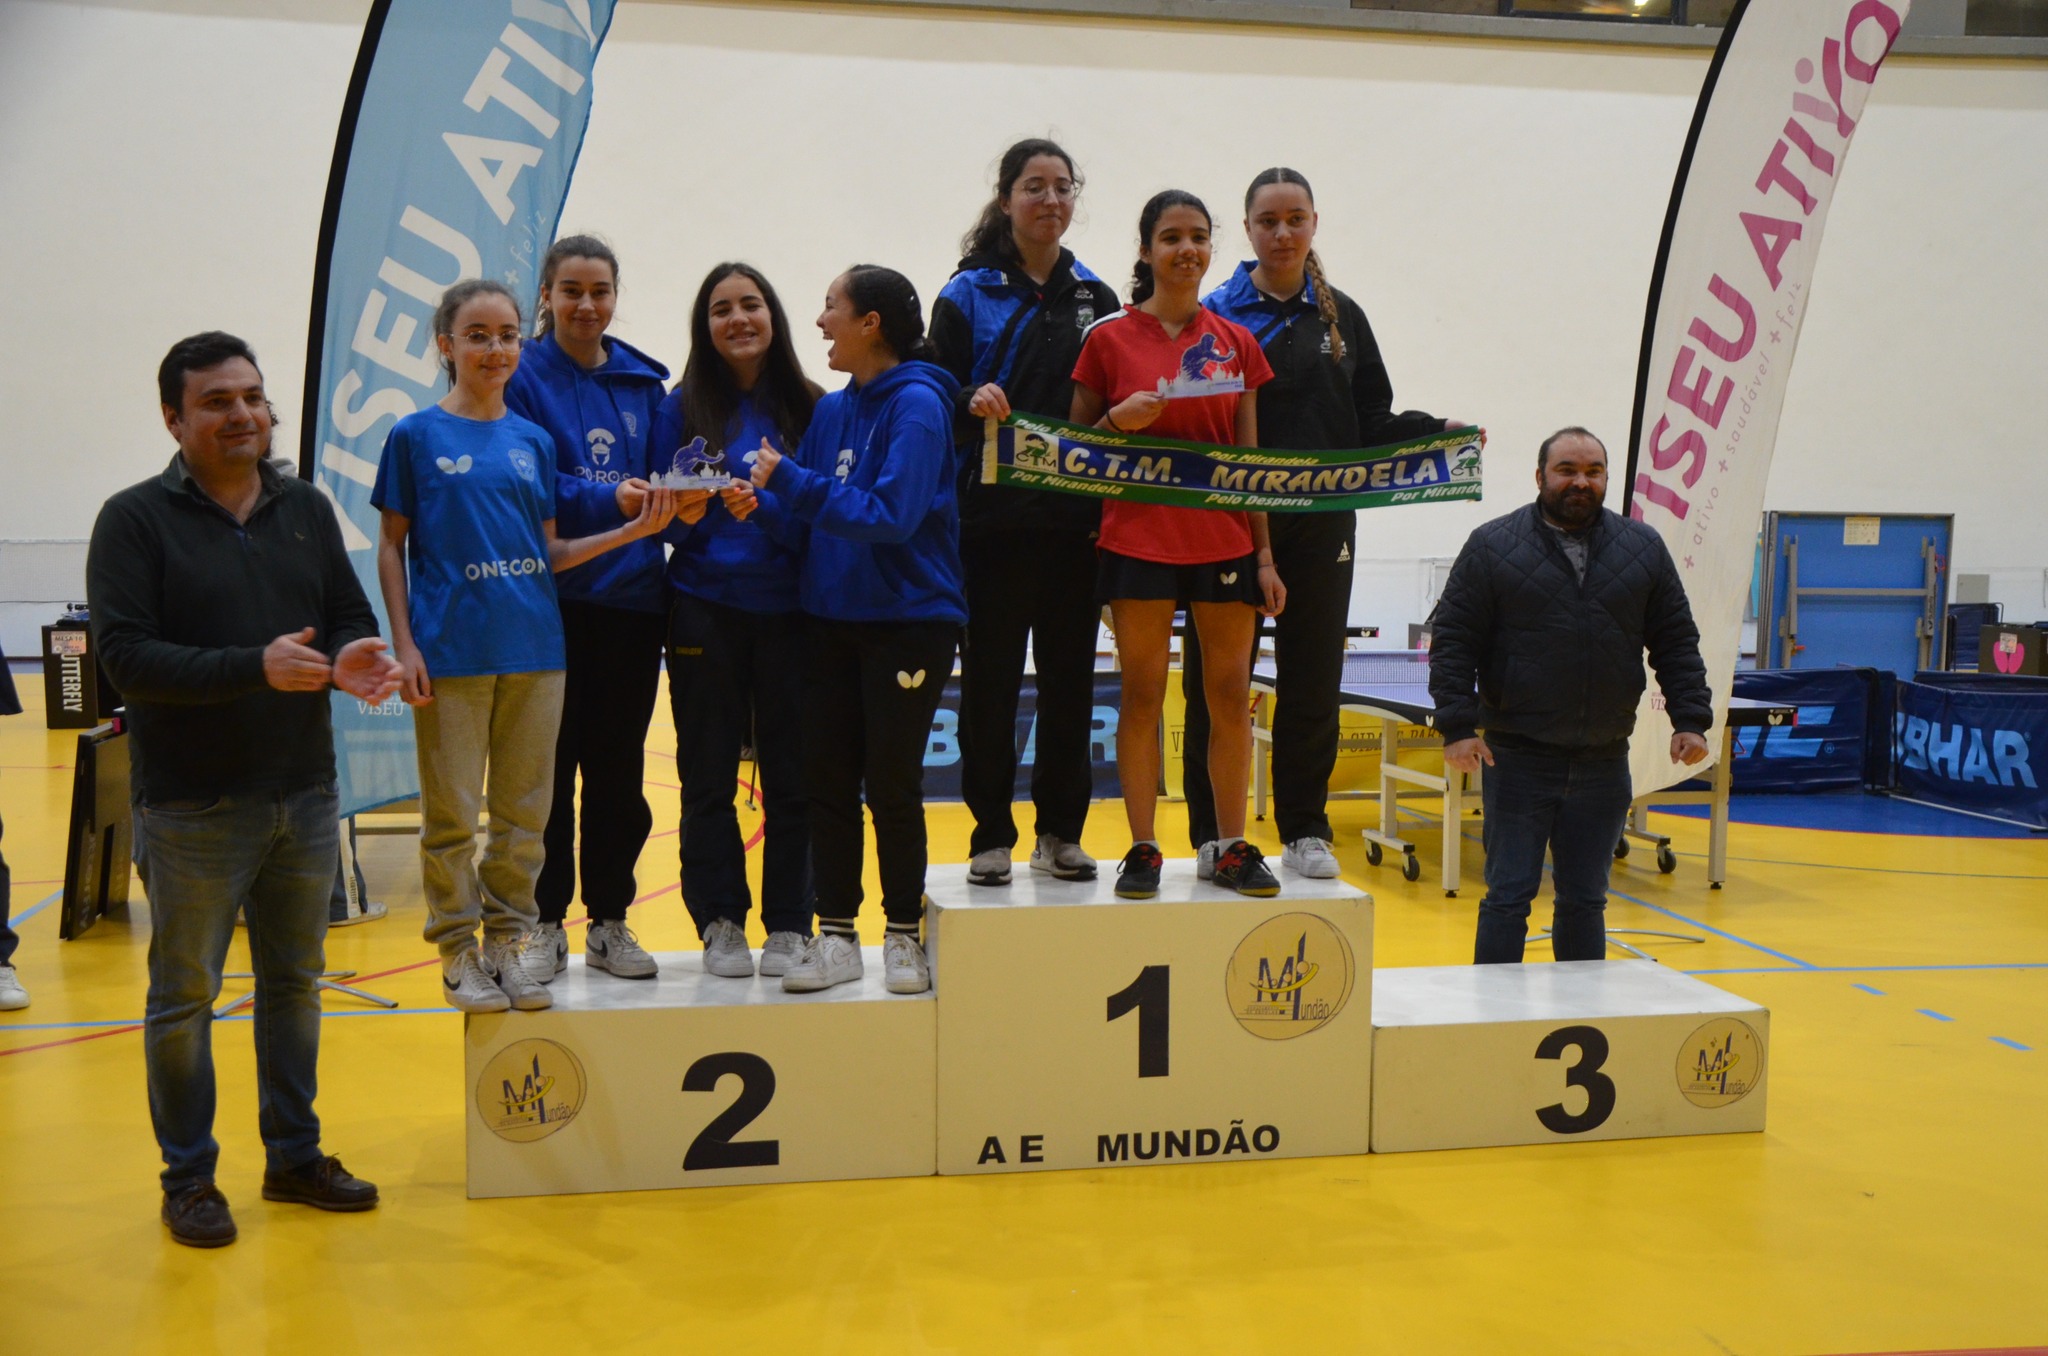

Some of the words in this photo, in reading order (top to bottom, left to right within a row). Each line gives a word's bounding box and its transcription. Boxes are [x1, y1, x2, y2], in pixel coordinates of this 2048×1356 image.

[1630, 272, 1757, 523] ISEU
[1692, 485, 1719, 547] ativo
[1726, 351, 1770, 455] saudável
[1775, 282, 1803, 329] feliz
[1013, 418, 1052, 434] Pelo
[1064, 446, 1182, 484] C.T.M.
[1209, 458, 1439, 494] MIRANDELA
[1206, 450, 1238, 461] Por
[1010, 470, 1040, 483] Por
[1041, 475, 1125, 496] Mirandela
[1204, 493, 1243, 505] Pelo
[1244, 494, 1315, 507] Desporto
[1391, 490, 1420, 502] Por
[61, 654, 83, 713] UTTERFLY
[1107, 964, 1171, 1079] 1
[1534, 1024, 1617, 1135] 3
[681, 1051, 780, 1172] 2
[1097, 1118, 1281, 1163] MUNDÃO
